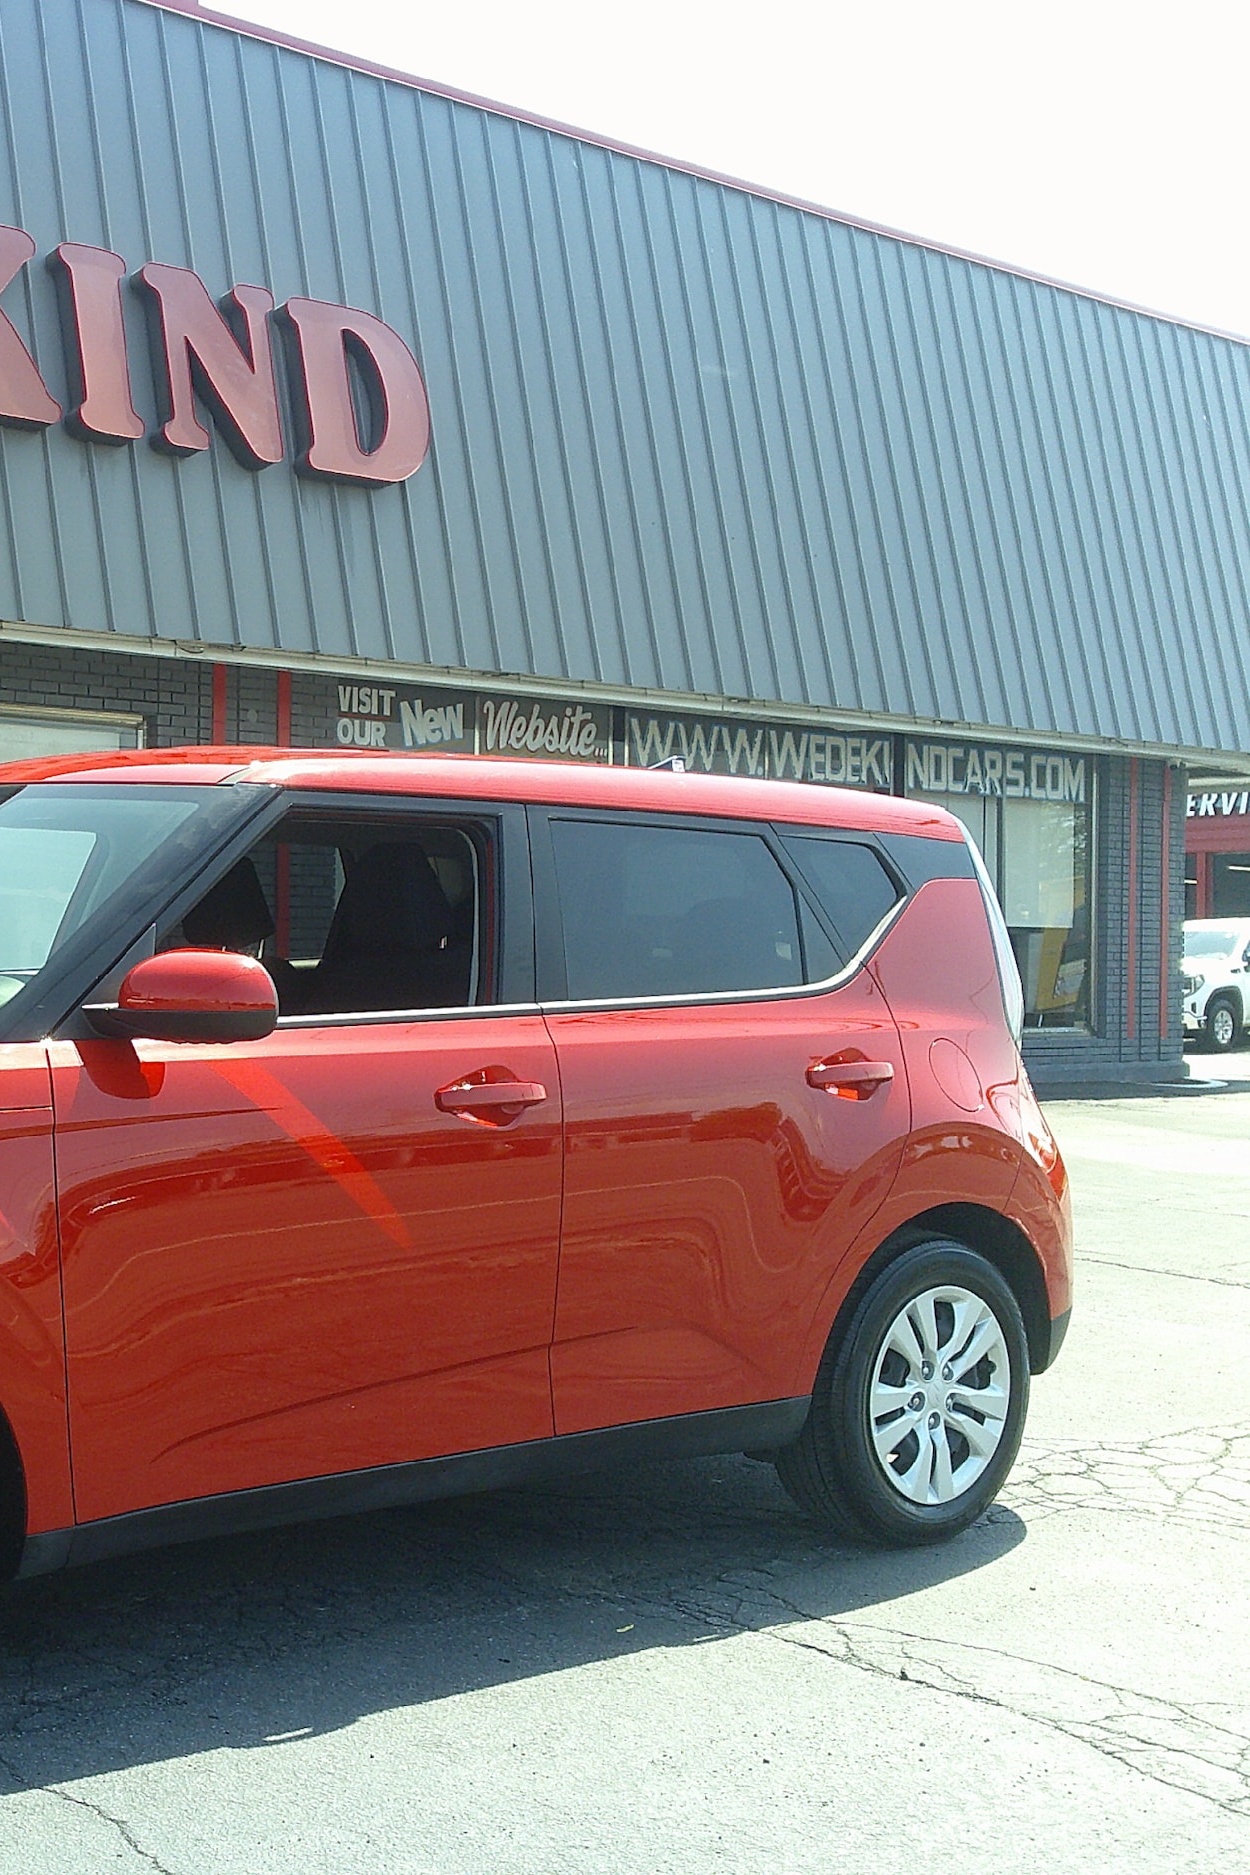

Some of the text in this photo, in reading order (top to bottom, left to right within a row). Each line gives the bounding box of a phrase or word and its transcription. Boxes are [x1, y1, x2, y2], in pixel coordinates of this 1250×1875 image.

[338, 685, 397, 717] VISIT
[336, 718, 387, 747] OUR
[400, 699, 464, 748] New
[1186, 791, 1249, 817] ERVI
